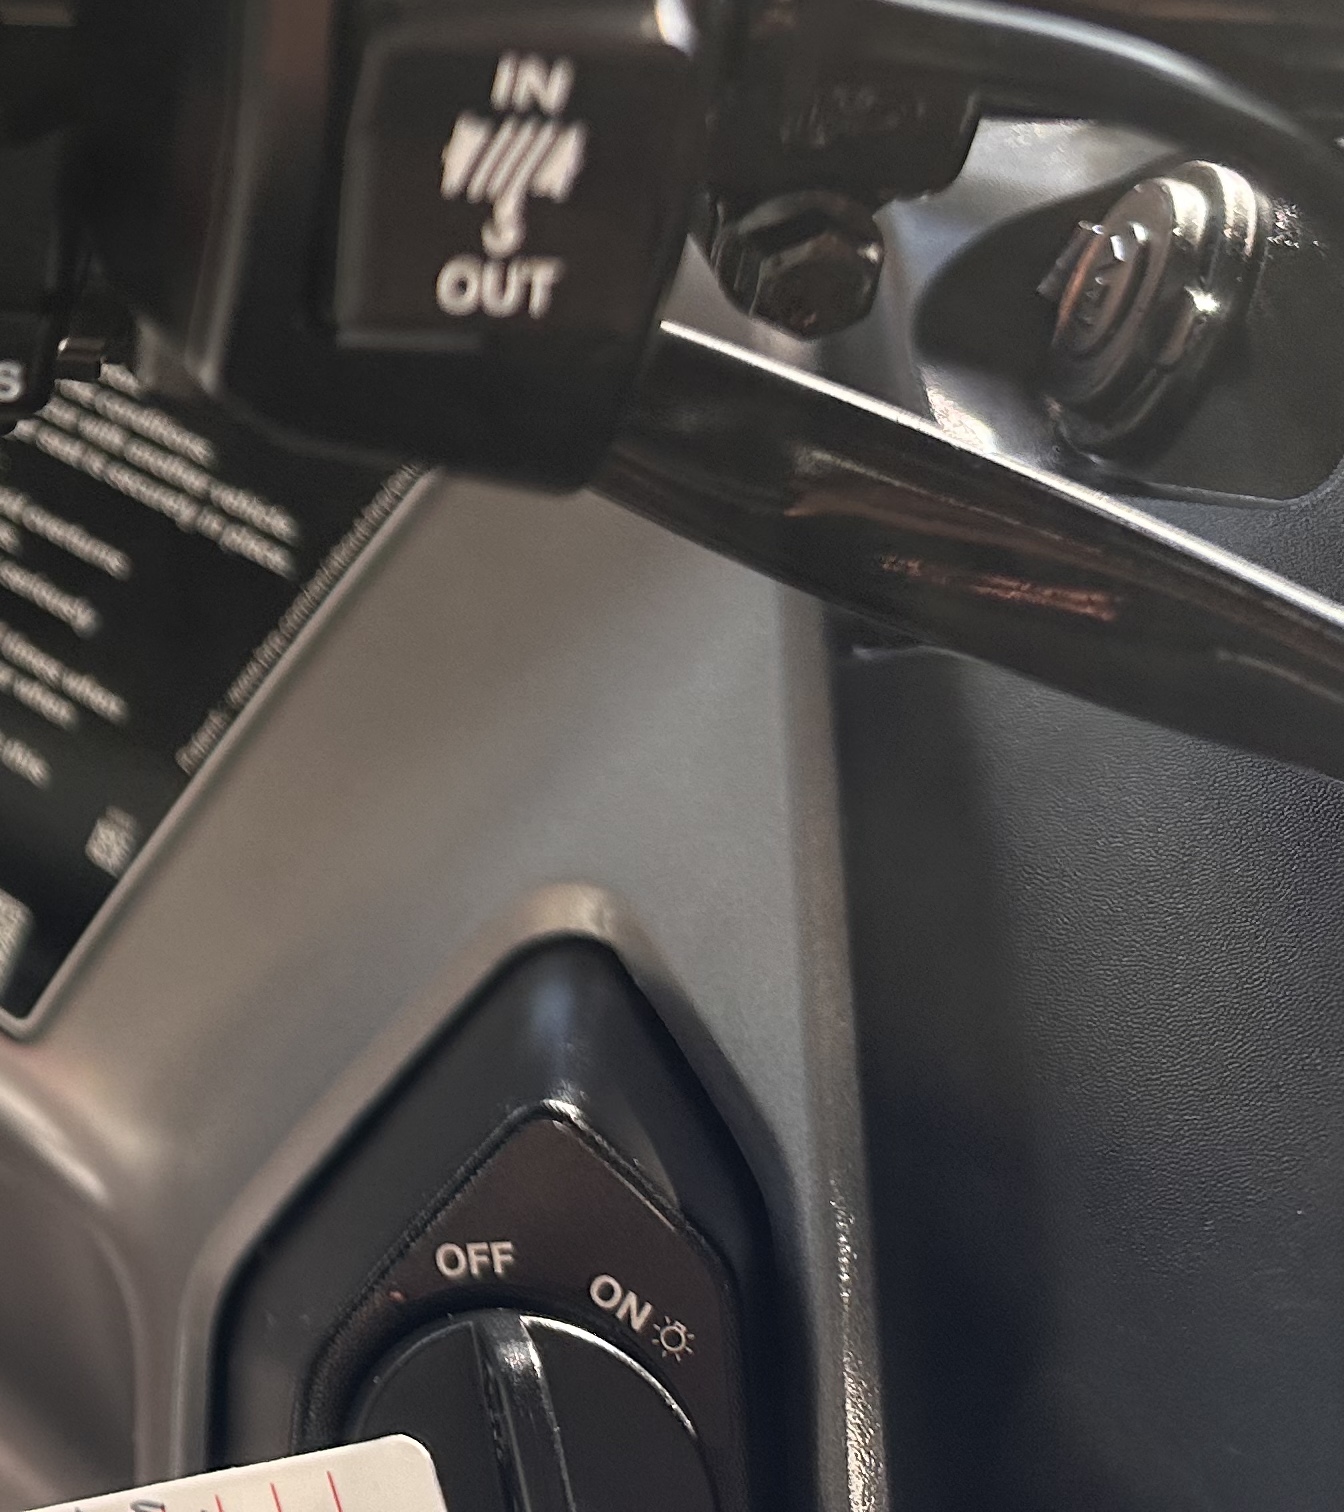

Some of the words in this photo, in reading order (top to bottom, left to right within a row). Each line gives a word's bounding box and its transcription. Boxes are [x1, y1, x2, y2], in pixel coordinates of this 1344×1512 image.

[490, 49, 577, 116] IN
[435, 252, 566, 319] OUT
[435, 1240, 515, 1278] OFF
[589, 1273, 654, 1333] ON
